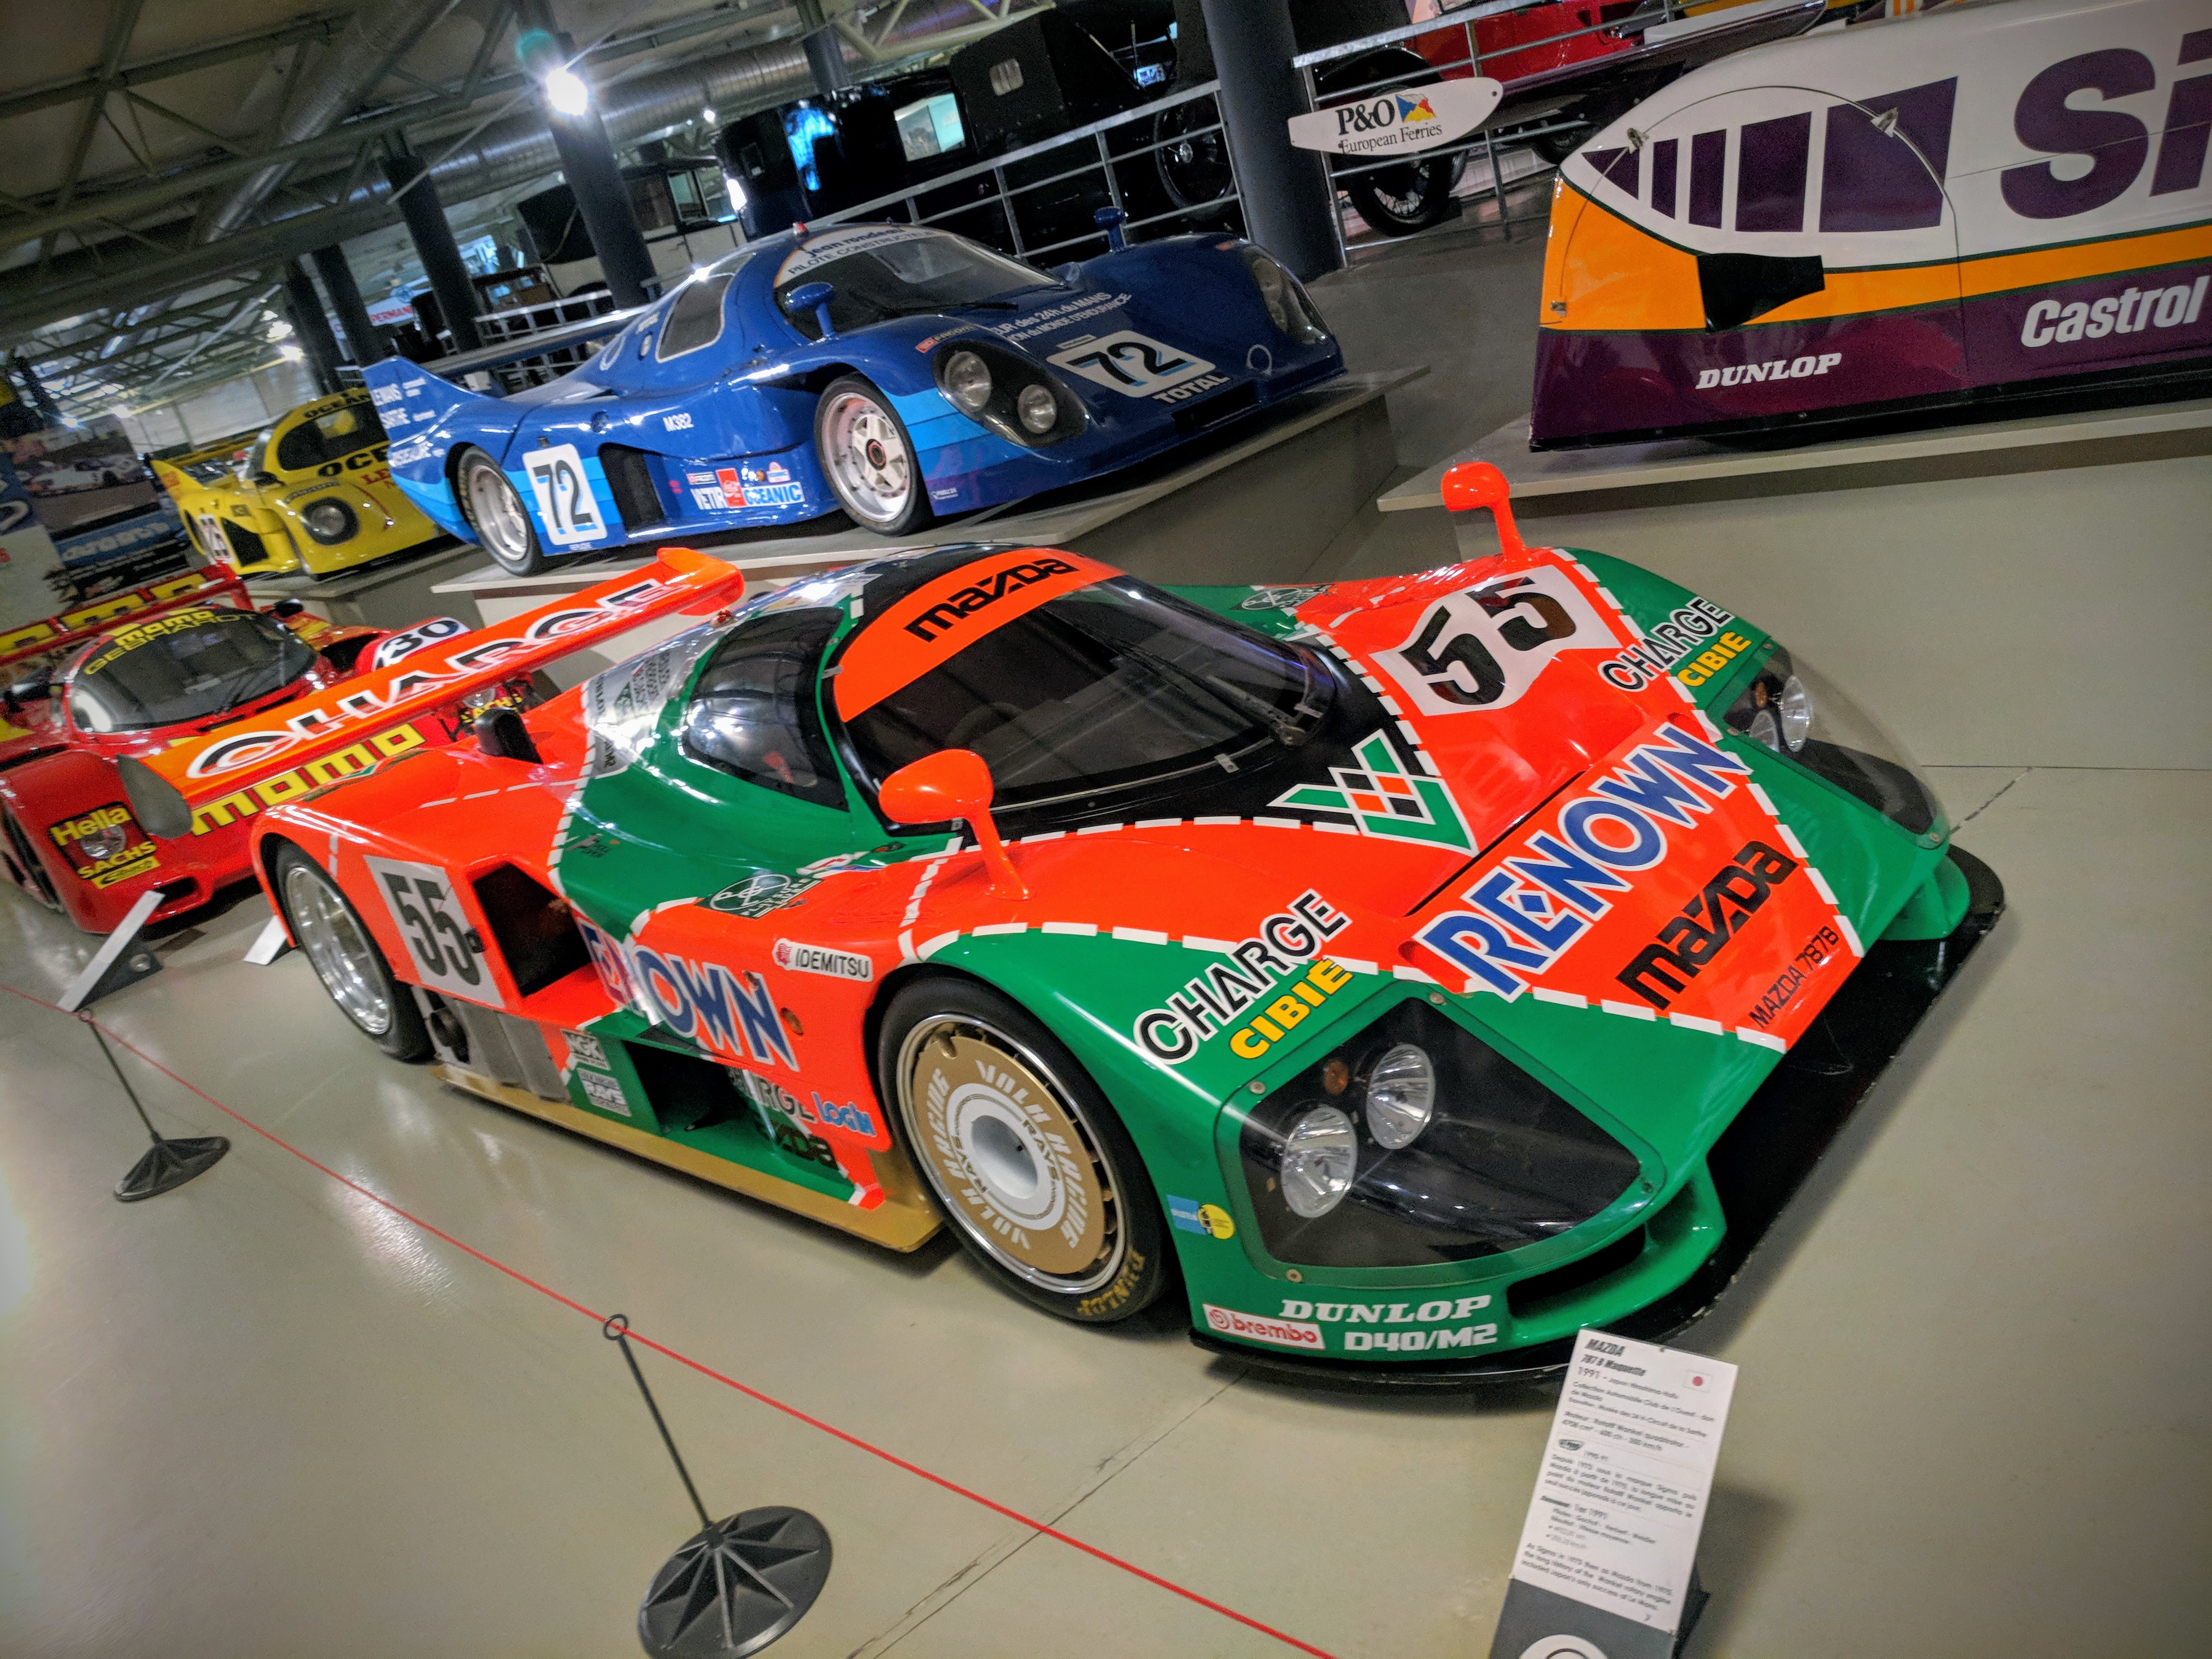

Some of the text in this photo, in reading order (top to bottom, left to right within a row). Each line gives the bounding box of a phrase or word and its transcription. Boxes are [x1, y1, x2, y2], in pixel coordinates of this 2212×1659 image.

[1336, 98, 1396, 136] P&O
[1340, 122, 1443, 156] European Ferries
[2001, 28, 2212, 220] Si
[787, 254, 832, 275] PILOTE
[2021, 275, 2211, 348] Castrol
[1066, 341, 1197, 387] 72
[1695, 351, 1842, 390] DUNLOP
[1152, 374, 1231, 404] TOTAL
[532, 459, 597, 536] 72
[903, 557, 1081, 643] mazda
[114, 609, 215, 646] momo
[380, 616, 460, 667] 30
[1399, 575, 1577, 706] 55
[1597, 597, 1739, 693] CHARGE
[186, 578, 690, 779] CHARGE
[191, 723, 428, 836] momo
[50, 807, 133, 846] Hella
[77, 840, 157, 879] SACHS
[1411, 722, 1754, 1004] RENOWN
[381, 870, 481, 986] 55
[1615, 840, 1799, 1011] mazda
[795, 949, 870, 979] IDEMITSU
[1133, 887, 1354, 1065] CHARGE
[1748, 925, 1840, 1029] MAZDA 787B
[1232, 1311, 1319, 1344] brembo
[1279, 1295, 1492, 1323] DUNLOP
[1344, 1323, 1498, 1352] D40/M2
[1584, 1337, 1626, 1358] MAZDA
